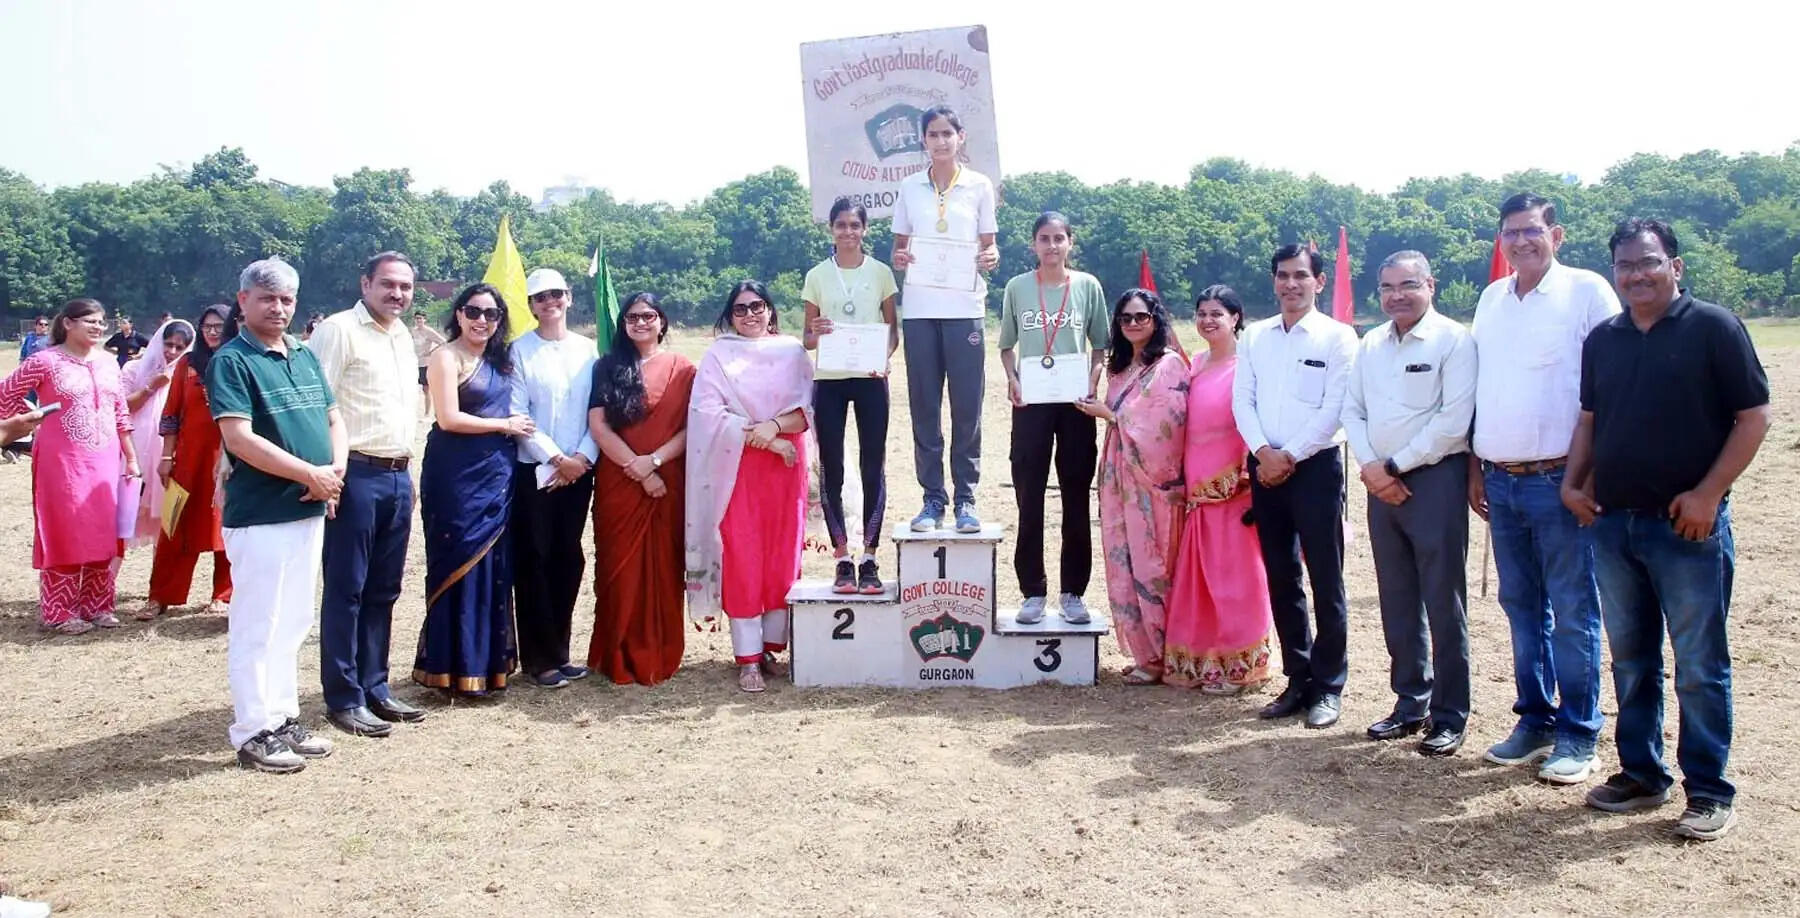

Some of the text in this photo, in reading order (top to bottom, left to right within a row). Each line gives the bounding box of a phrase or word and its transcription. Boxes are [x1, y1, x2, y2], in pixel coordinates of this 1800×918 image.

[935, 49, 979, 90] College
[842, 161, 878, 181] CITIUS
[1021, 309, 1084, 331] COOL
[933, 546, 946, 579] 1
[933, 581, 986, 602] COLLEGE
[832, 608, 854, 640] 2
[1033, 638, 1062, 673] 3
[920, 668, 974, 681] GURGAON
